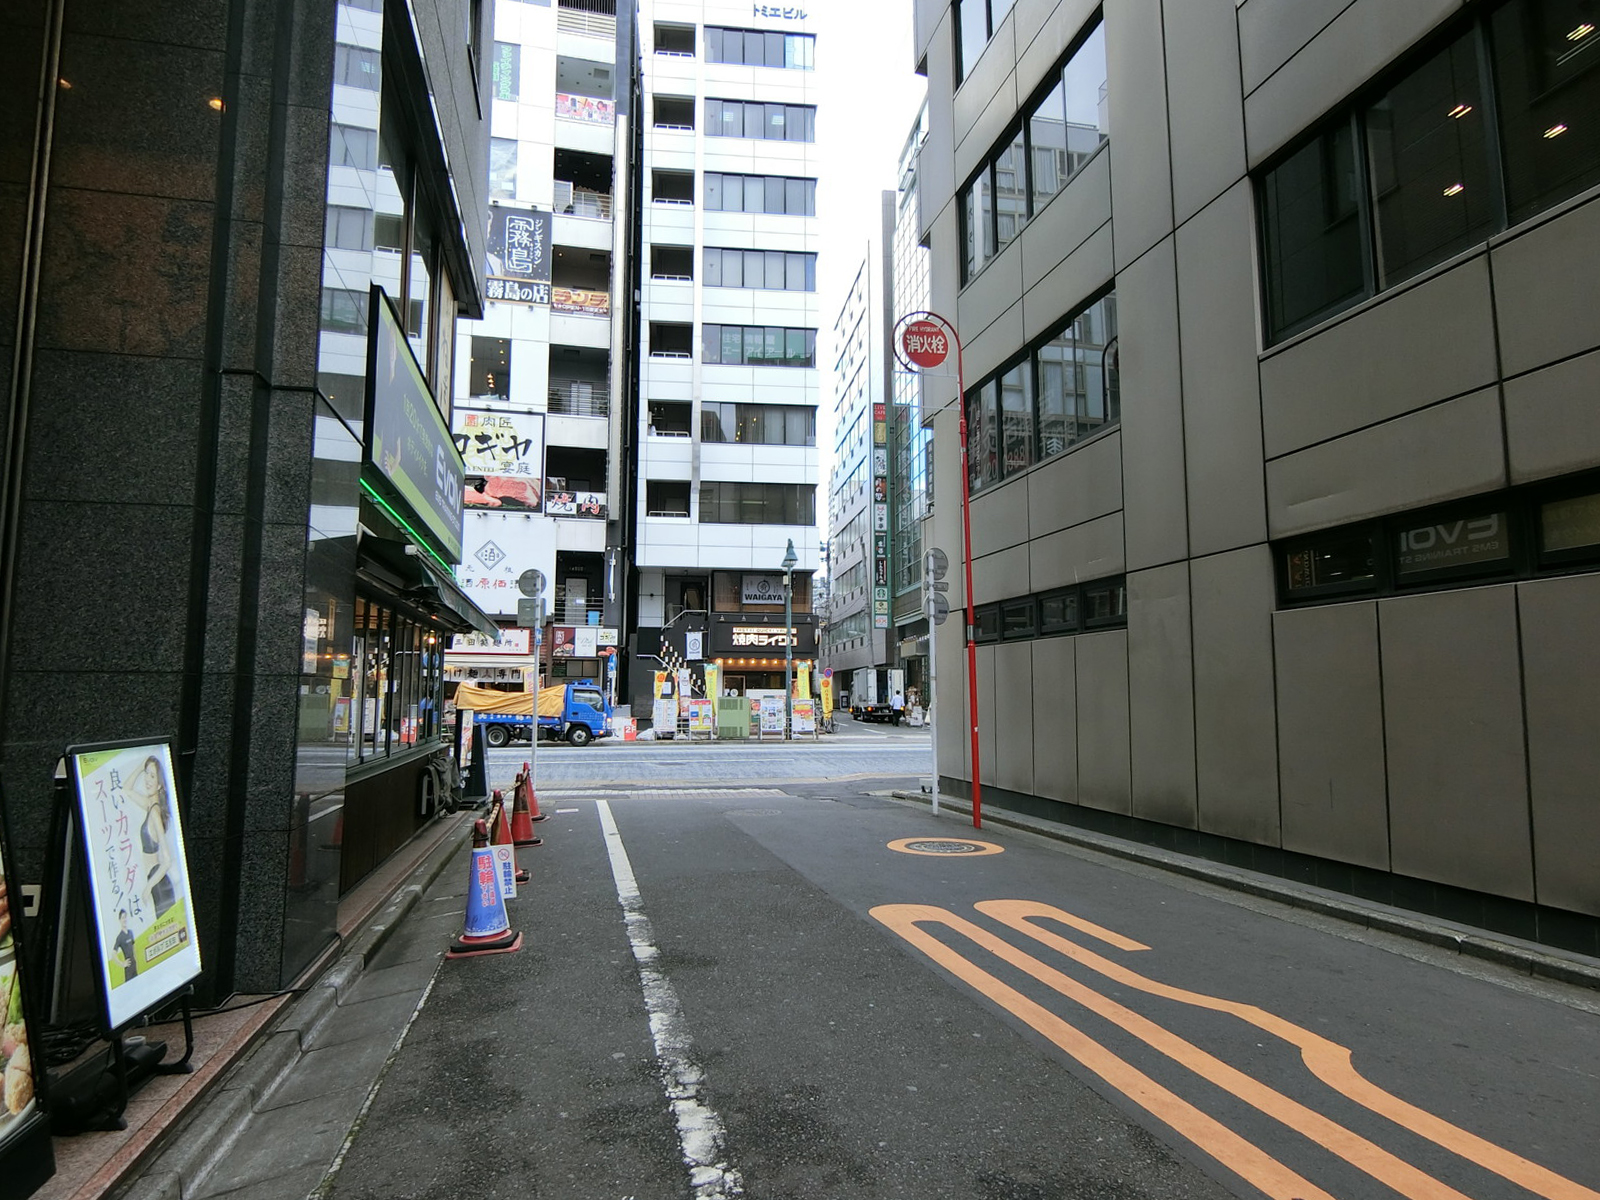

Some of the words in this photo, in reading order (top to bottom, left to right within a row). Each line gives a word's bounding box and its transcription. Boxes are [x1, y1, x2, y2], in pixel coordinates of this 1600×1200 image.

[753, 4, 808, 19] トミエビル
[508, 219, 533, 269] 霧島
[534, 219, 543, 264] ジンギスカン
[487, 280, 549, 304] 霧島の店
[906, 335, 946, 354] 消火栓
[481, 416, 513, 429] 肉匠
[500, 461, 532, 475] 宴庭
[552, 492, 600, 515] 焼肉
[744, 593, 783, 601] WAIGAYA
[109, 768, 144, 923] 良いカラダは、
[503, 861, 514, 895] 駐輪禁止
